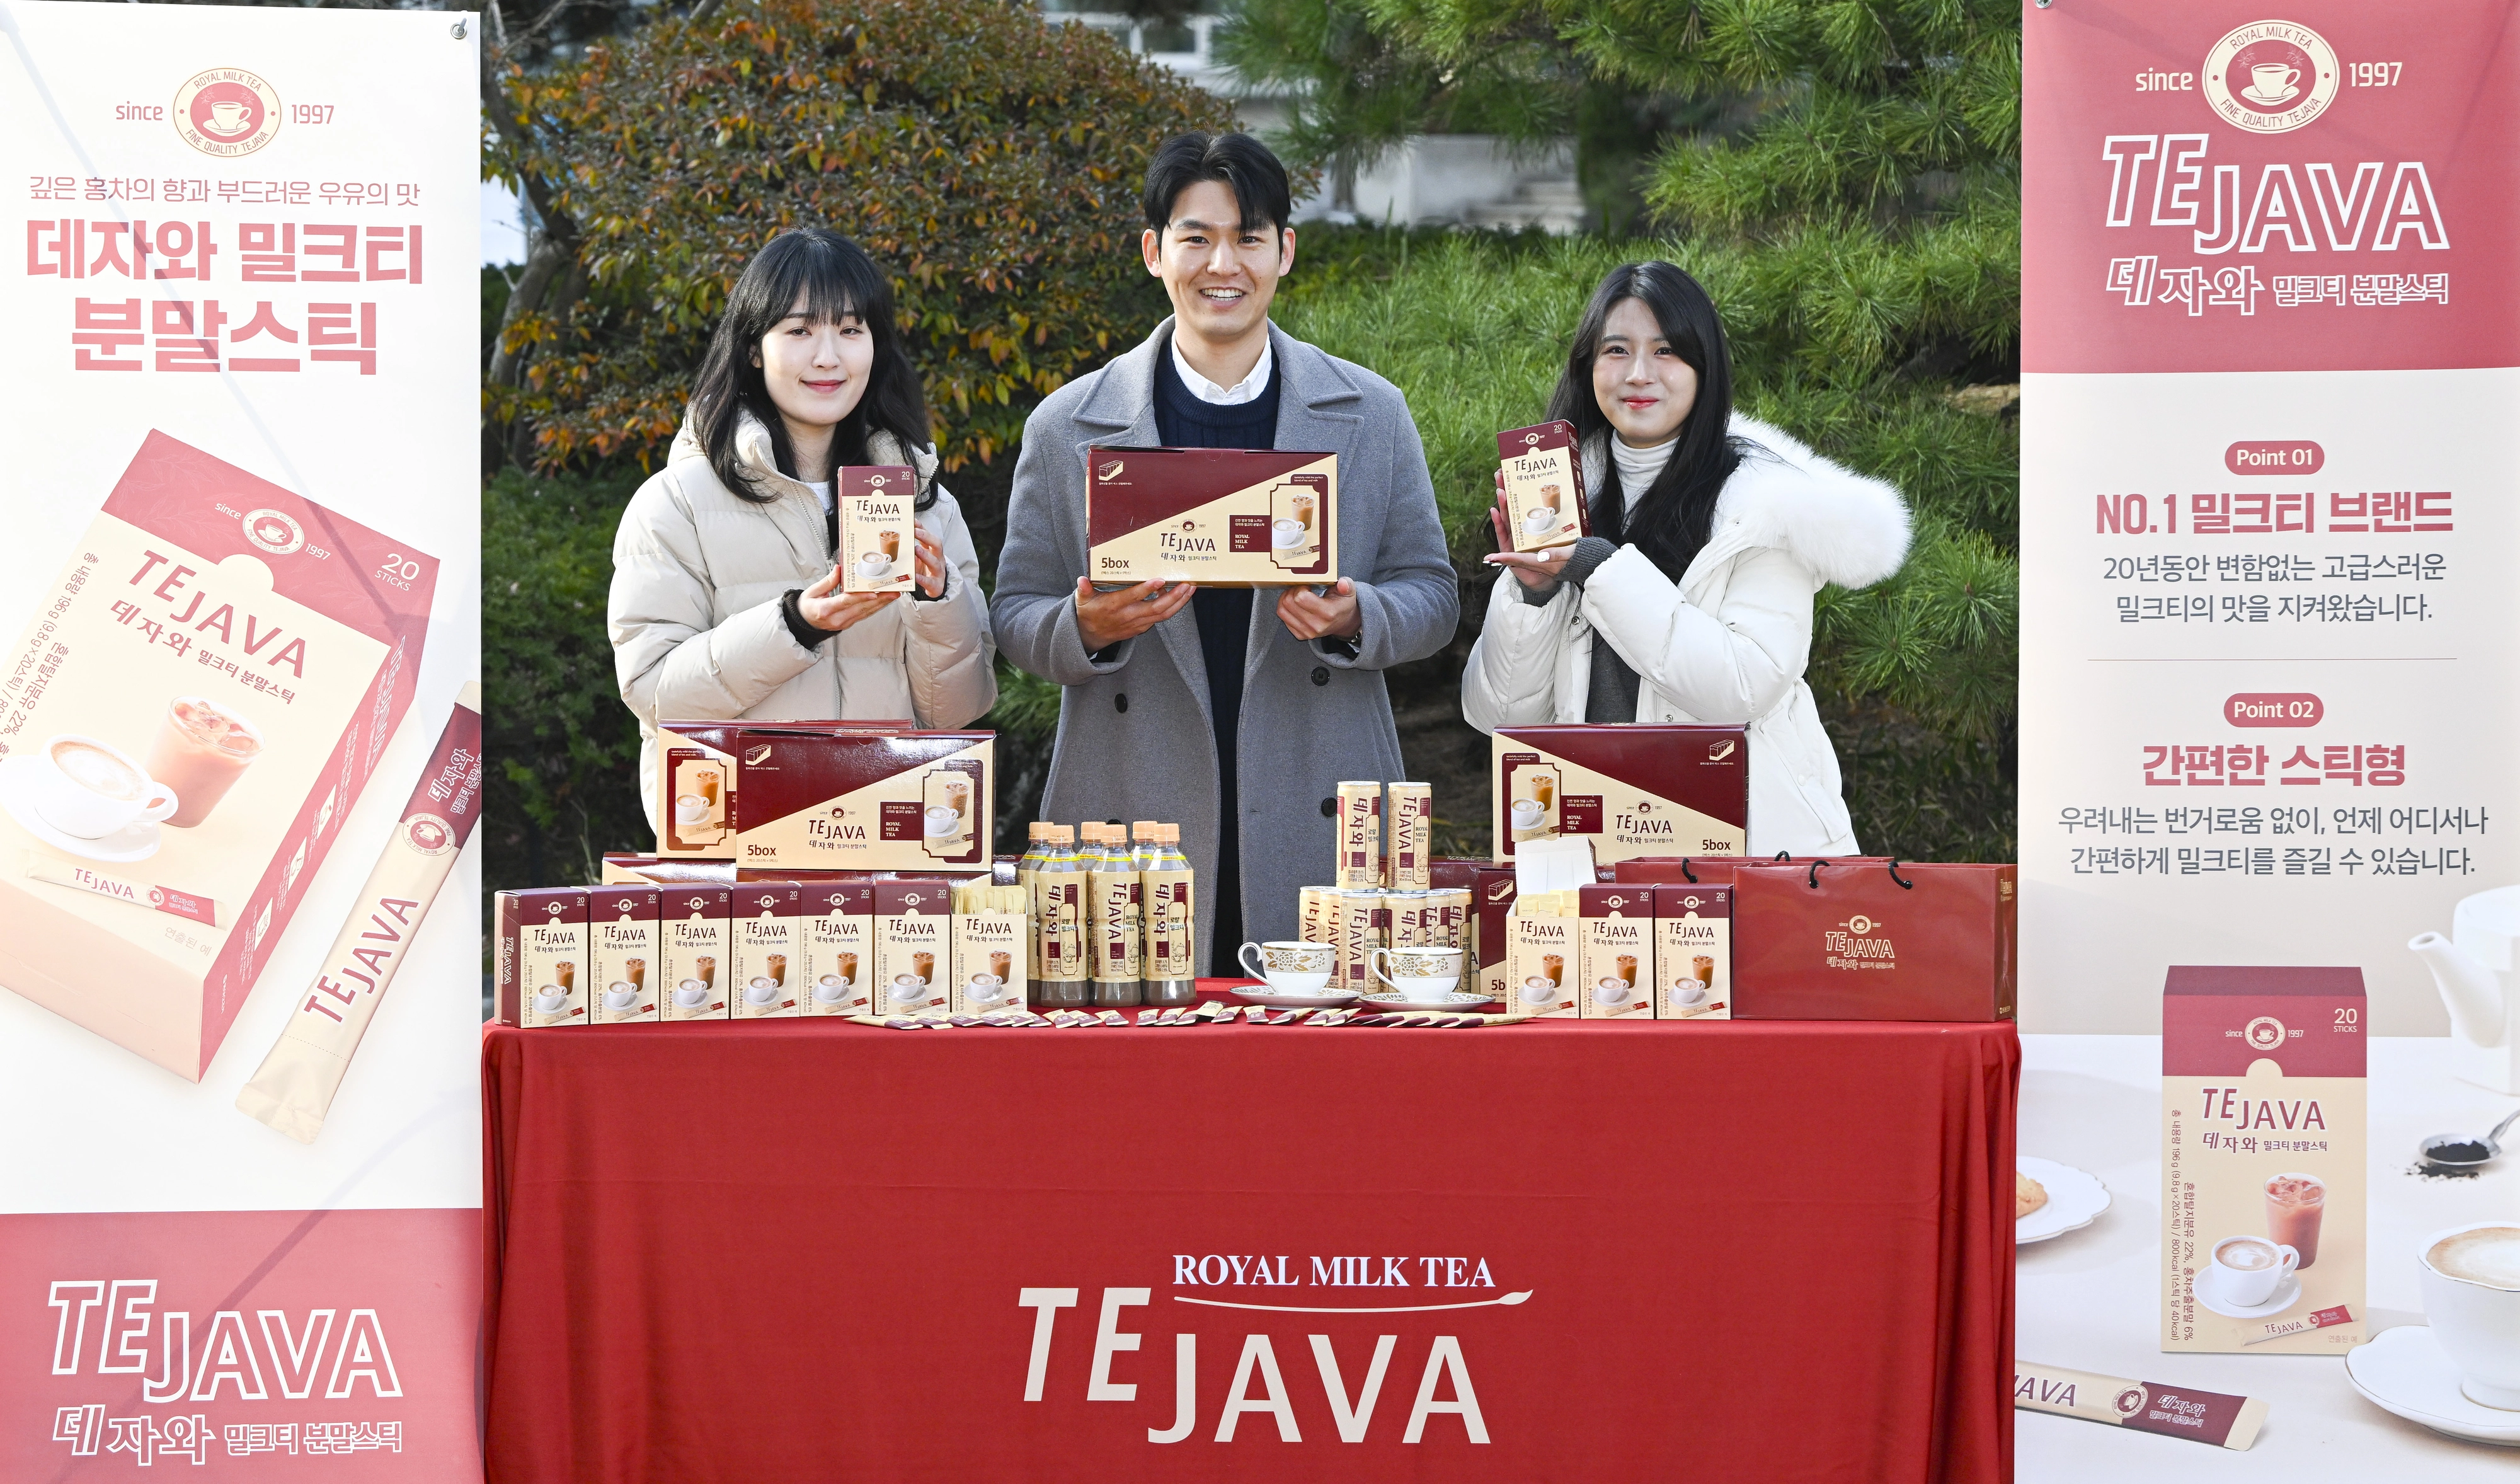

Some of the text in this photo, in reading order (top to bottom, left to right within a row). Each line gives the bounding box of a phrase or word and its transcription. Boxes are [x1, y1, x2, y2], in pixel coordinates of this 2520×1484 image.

[2230, 26, 2313, 50] ROYAL MILK TEA
[193, 71, 263, 93] ROYAL MILK TEA
[2135, 62, 2402, 92] since 1997
[115, 101, 335, 125] since 1997
[2221, 98, 2322, 127] FINE QUALITY TEJAVA
[185, 129, 270, 154] FINE QUALITY TEJAVA
[30, 176, 420, 207] 깊은 홍차의 향과 부드러운 우유의 맛
[2102, 133, 2450, 255] TEJAVA
[27, 218, 423, 284] 데자와 밀크티
[2105, 255, 2448, 316] 데자와 밀크티 분말스틱
[72, 297, 376, 376] 분말스틱
[1515, 457, 1557, 473] TEJAVA
[2236, 449, 2312, 466] Point 01
[856, 500, 900, 515] TEJAVA
[2096, 492, 2453, 534] NO.1 밀크티 브랜드
[214, 503, 331, 560] since 1997
[1160, 533, 1216, 551] TEJAVA
[381, 553, 420, 580] 20
[1101, 557, 1130, 568] 5box
[1160, 552, 1186, 561] 데자와
[2104, 553, 2446, 582] 20년동안 변함없는 고급스러운
[374, 570, 411, 592] STICKS
[129, 549, 307, 679] TEJAVA
[2117, 593, 2432, 623] 밀크티의 맛을 지켜왔습니다.
[110, 599, 296, 705] 데자와 밀크티 분말스틱
[2234, 701, 2314, 718] Point 02
[428, 748, 474, 802] 데자와
[2142, 744, 2406, 786] 간편한 스틱형
[810, 820, 866, 839] TEJAVA
[1349, 798, 1368, 846] 데자와
[1398, 797, 1417, 849] TEJAVA
[1617, 815, 1673, 834] TEJAVA
[2058, 806, 2488, 836] 우려내는 번거로움 없이, 언제 어디서나
[747, 844, 776, 856] 5box
[810, 840, 835, 849] 데자와
[1617, 835, 1642, 844] 데자와
[1702, 839, 1731, 850] 5box
[2070, 847, 2476, 875] 간편하게 밀크티를 즐길 수 있습니다.
[75, 868, 134, 899] TEJAVA
[1046, 885, 1061, 936] 데자와
[1108, 883, 1126, 940] TEJAVA
[1153, 884, 1169, 936] 데자와
[534, 929, 575, 944] TEJAVA
[605, 926, 646, 941] TEJAVA
[675, 924, 716, 939] TEJAVA
[746, 922, 787, 937] TEJAVA
[815, 920, 858, 935] TEJAVA
[890, 919, 935, 935] TEJAVA
[966, 919, 1011, 934] TEJAVA
[1349, 909, 1367, 961] TEJAVA
[1520, 921, 1564, 937] TEJAVA
[1593, 922, 1637, 937] TEJAVA
[1670, 923, 1714, 938] TEJAVA
[164, 926, 212, 957] 연출된 예
[1826, 931, 1895, 958] TEJAVA
[304, 897, 419, 1023] TEJAVA
[1827, 957, 1858, 970] 데자와
[2334, 1008, 2357, 1024] 20
[2202, 1088, 2325, 1130] TEJAVA
[2202, 1132, 2328, 1154] 데자와 밀크티 분말스틱
[1172, 1254, 1496, 1288] ROYAL MILK TEA
[2184, 1182, 2195, 1341] 혼합탈지분유 6%
[2265, 1321, 2303, 1334] TEJAVA
[48, 1279, 403, 1403] TEJAVA
[1018, 1287, 1491, 1445] TEJAVA
[2150, 1410, 2172, 1422] 밀크티
[2158, 1395, 2206, 1417] 데자와
[52, 1404, 402, 1466] 데자와 밀크티 분말스틱
